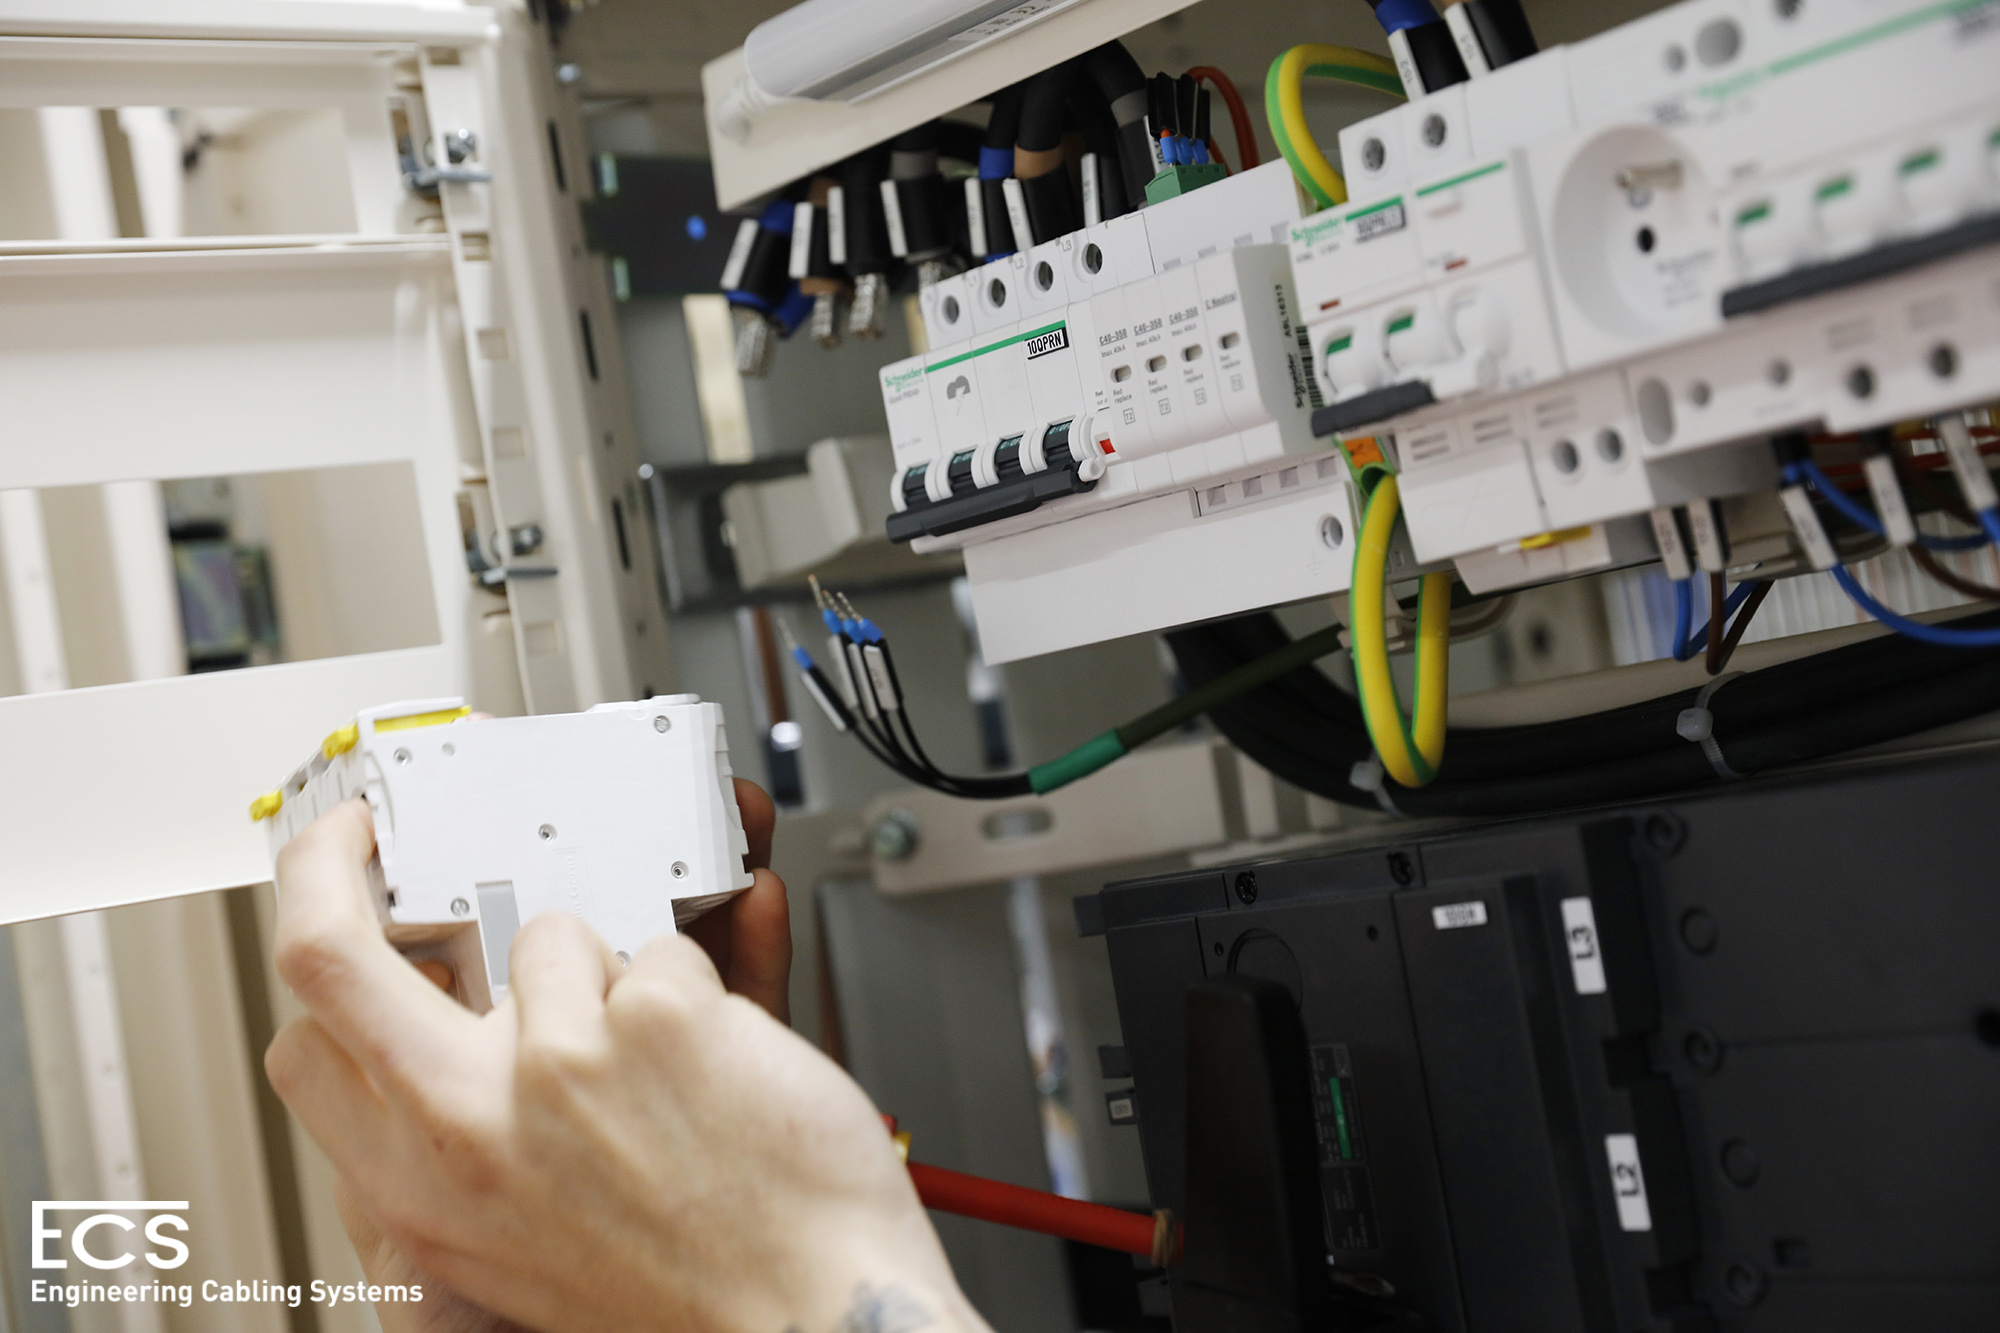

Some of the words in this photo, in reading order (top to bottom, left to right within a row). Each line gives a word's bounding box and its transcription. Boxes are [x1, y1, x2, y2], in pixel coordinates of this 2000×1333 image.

[1061, 239, 1072, 251] L3
[1013, 257, 1025, 269] L2
[1169, 306, 1199, 325] C40-350
[1134, 317, 1163, 336] C40-350
[1026, 331, 1062, 355] 10QPRN
[1099, 328, 1128, 346] C40-350
[1148, 379, 1158, 387] Red
[1150, 383, 1168, 395] replace
[1113, 388, 1123, 396] Red
[1114, 394, 1132, 405] replace
[1125, 412, 1134, 421] T2
[1571, 925, 1595, 960] L3
[1616, 1163, 1640, 1197] L2
